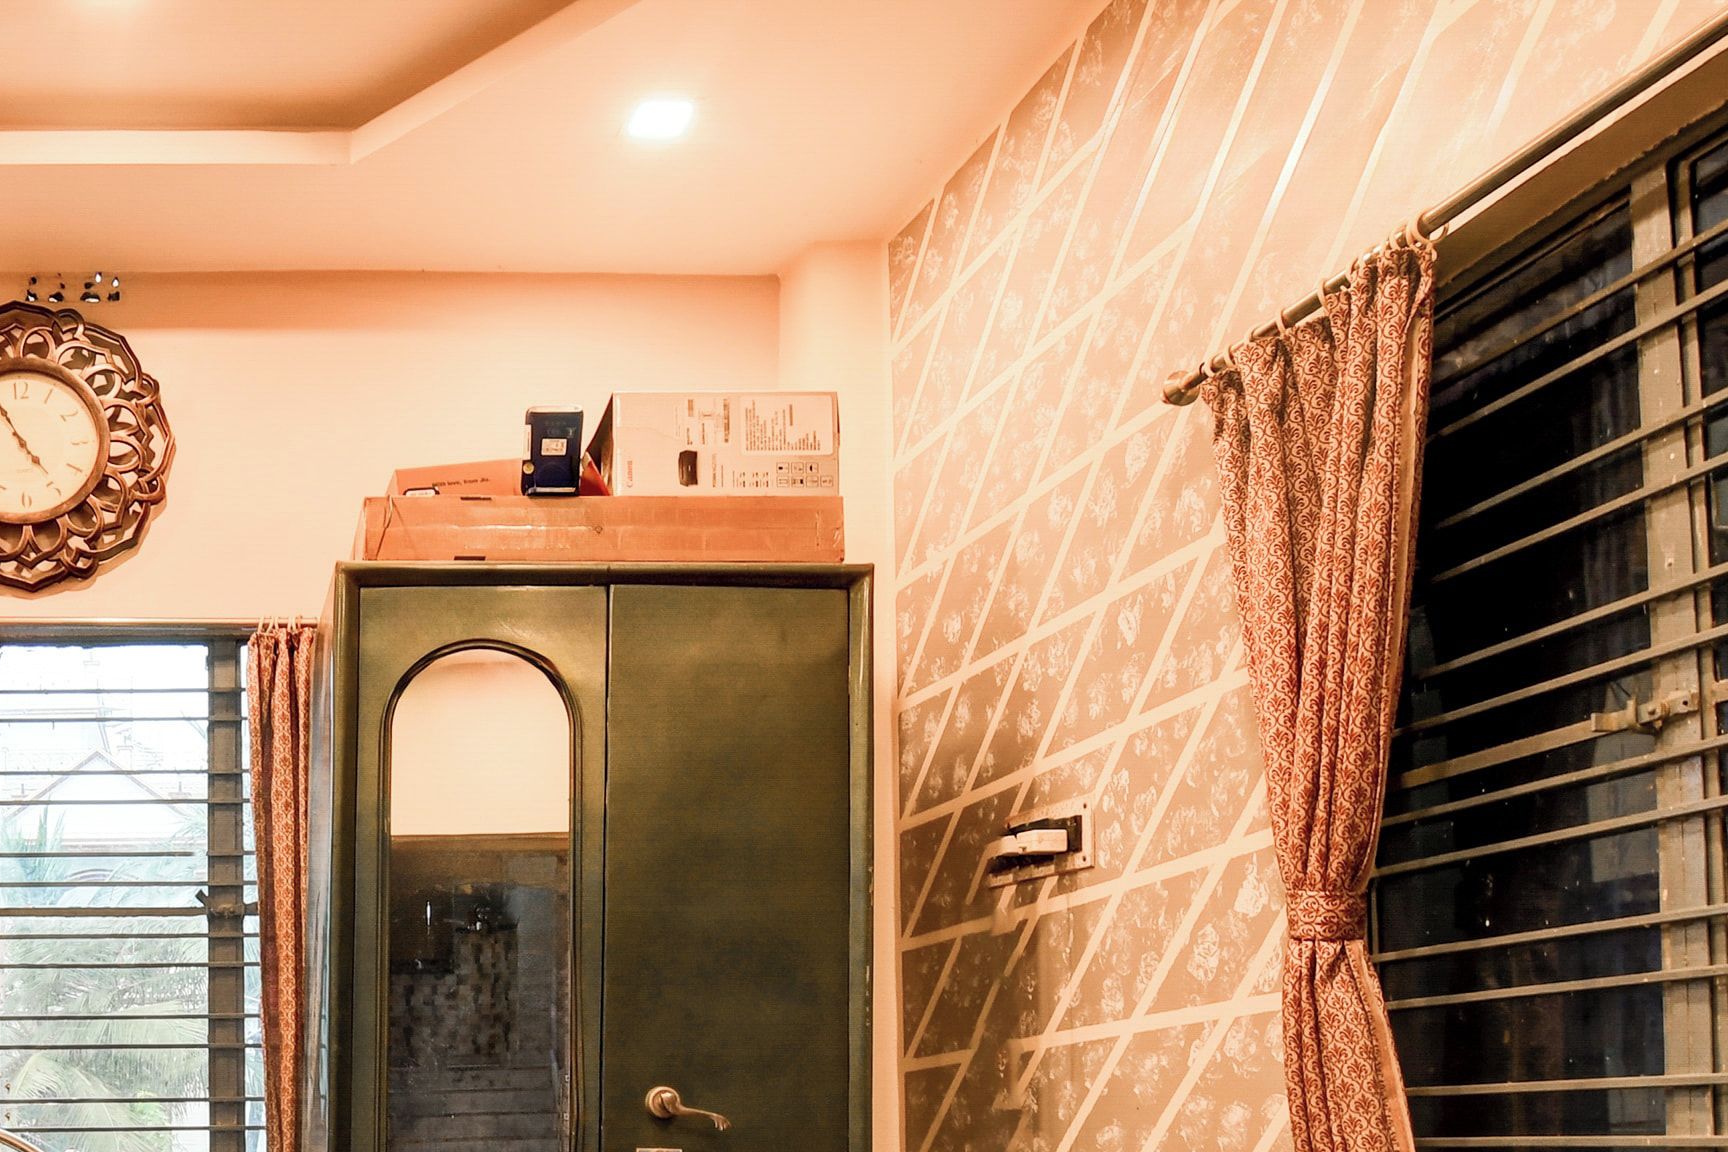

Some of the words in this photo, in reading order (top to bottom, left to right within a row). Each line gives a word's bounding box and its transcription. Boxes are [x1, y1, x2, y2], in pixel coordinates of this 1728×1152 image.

[12, 381, 29, 400] 12
[43, 387, 54, 405] 1
[59, 408, 79, 423] 2
